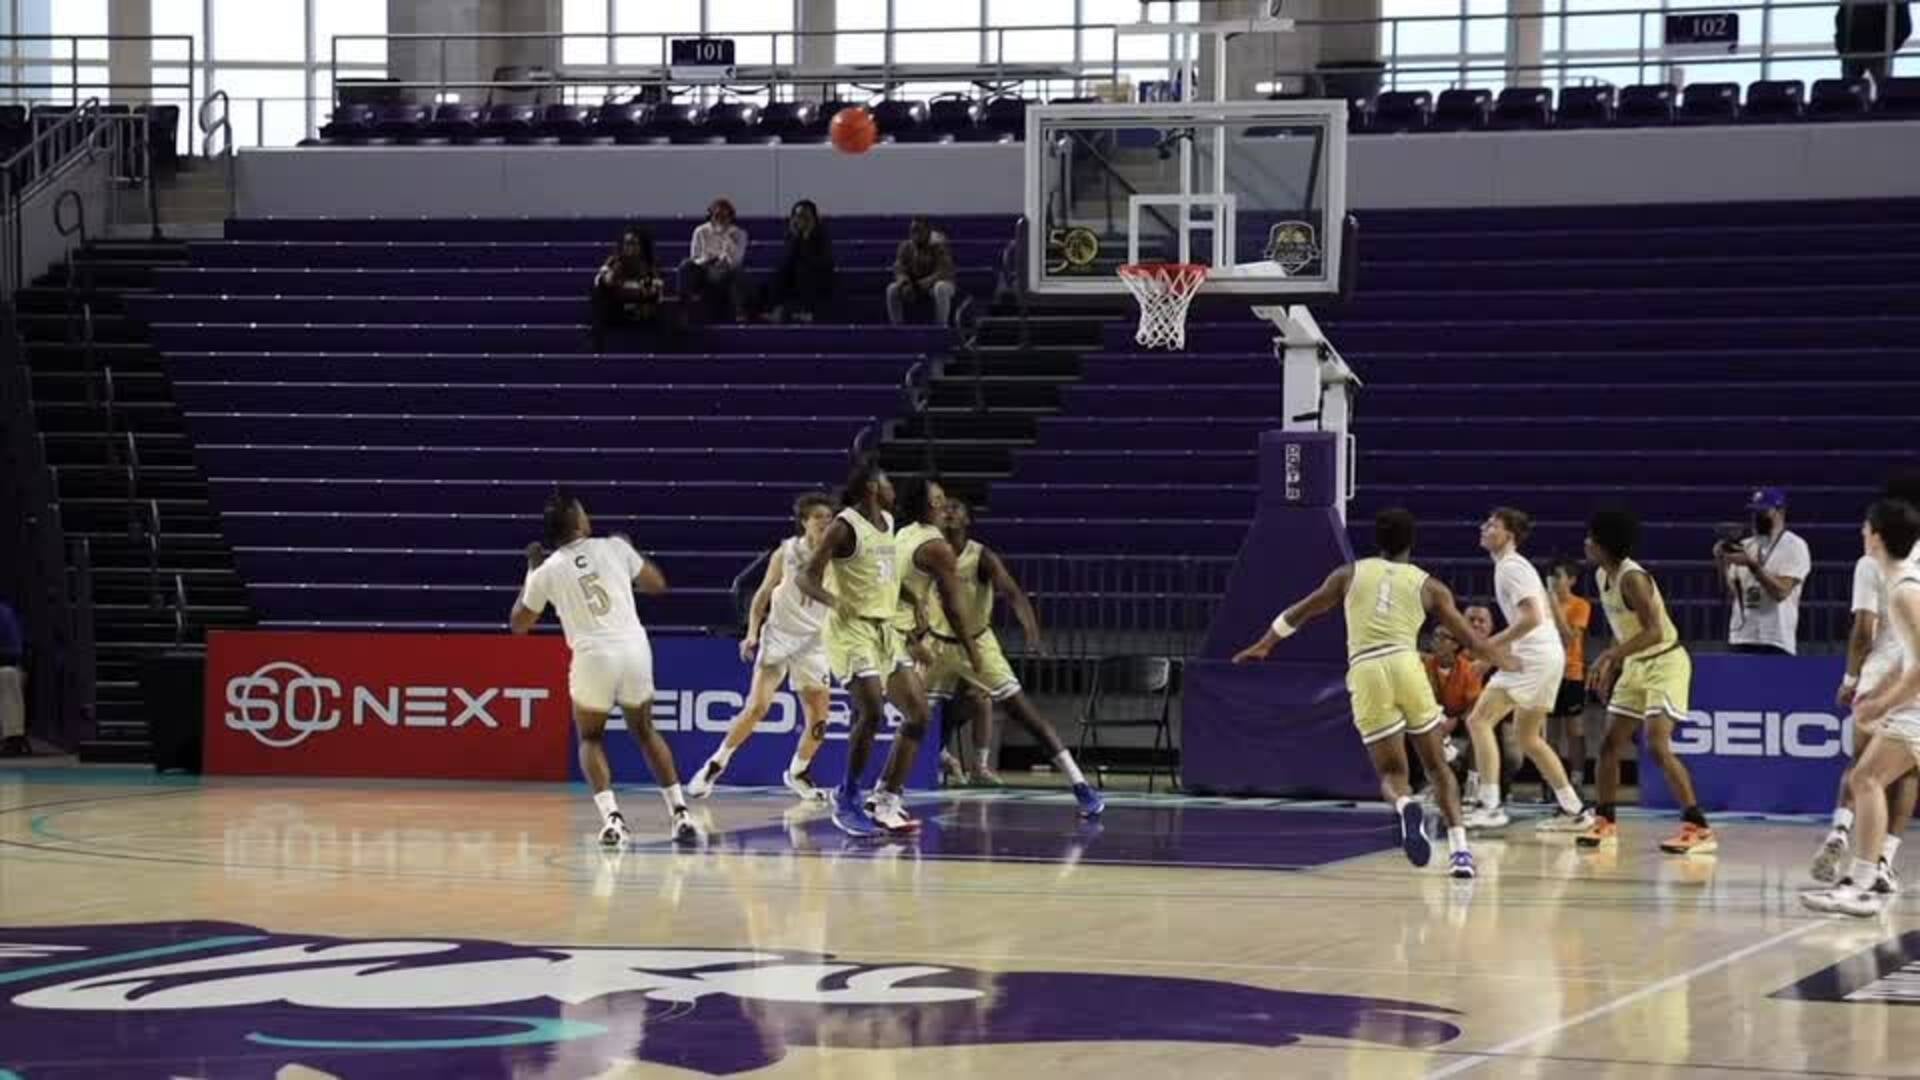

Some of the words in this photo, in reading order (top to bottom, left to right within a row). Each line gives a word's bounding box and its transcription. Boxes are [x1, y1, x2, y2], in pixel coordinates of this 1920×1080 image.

[1693, 17, 1727, 36] 102
[696, 43, 723, 60] 101
[574, 555, 588, 569] C
[577, 574, 610, 617] 5
[225, 676, 342, 731] SC
[352, 686, 549, 728] NEXT
[604, 690, 796, 733] EICO
[1671, 710, 1856, 758] GEIC
